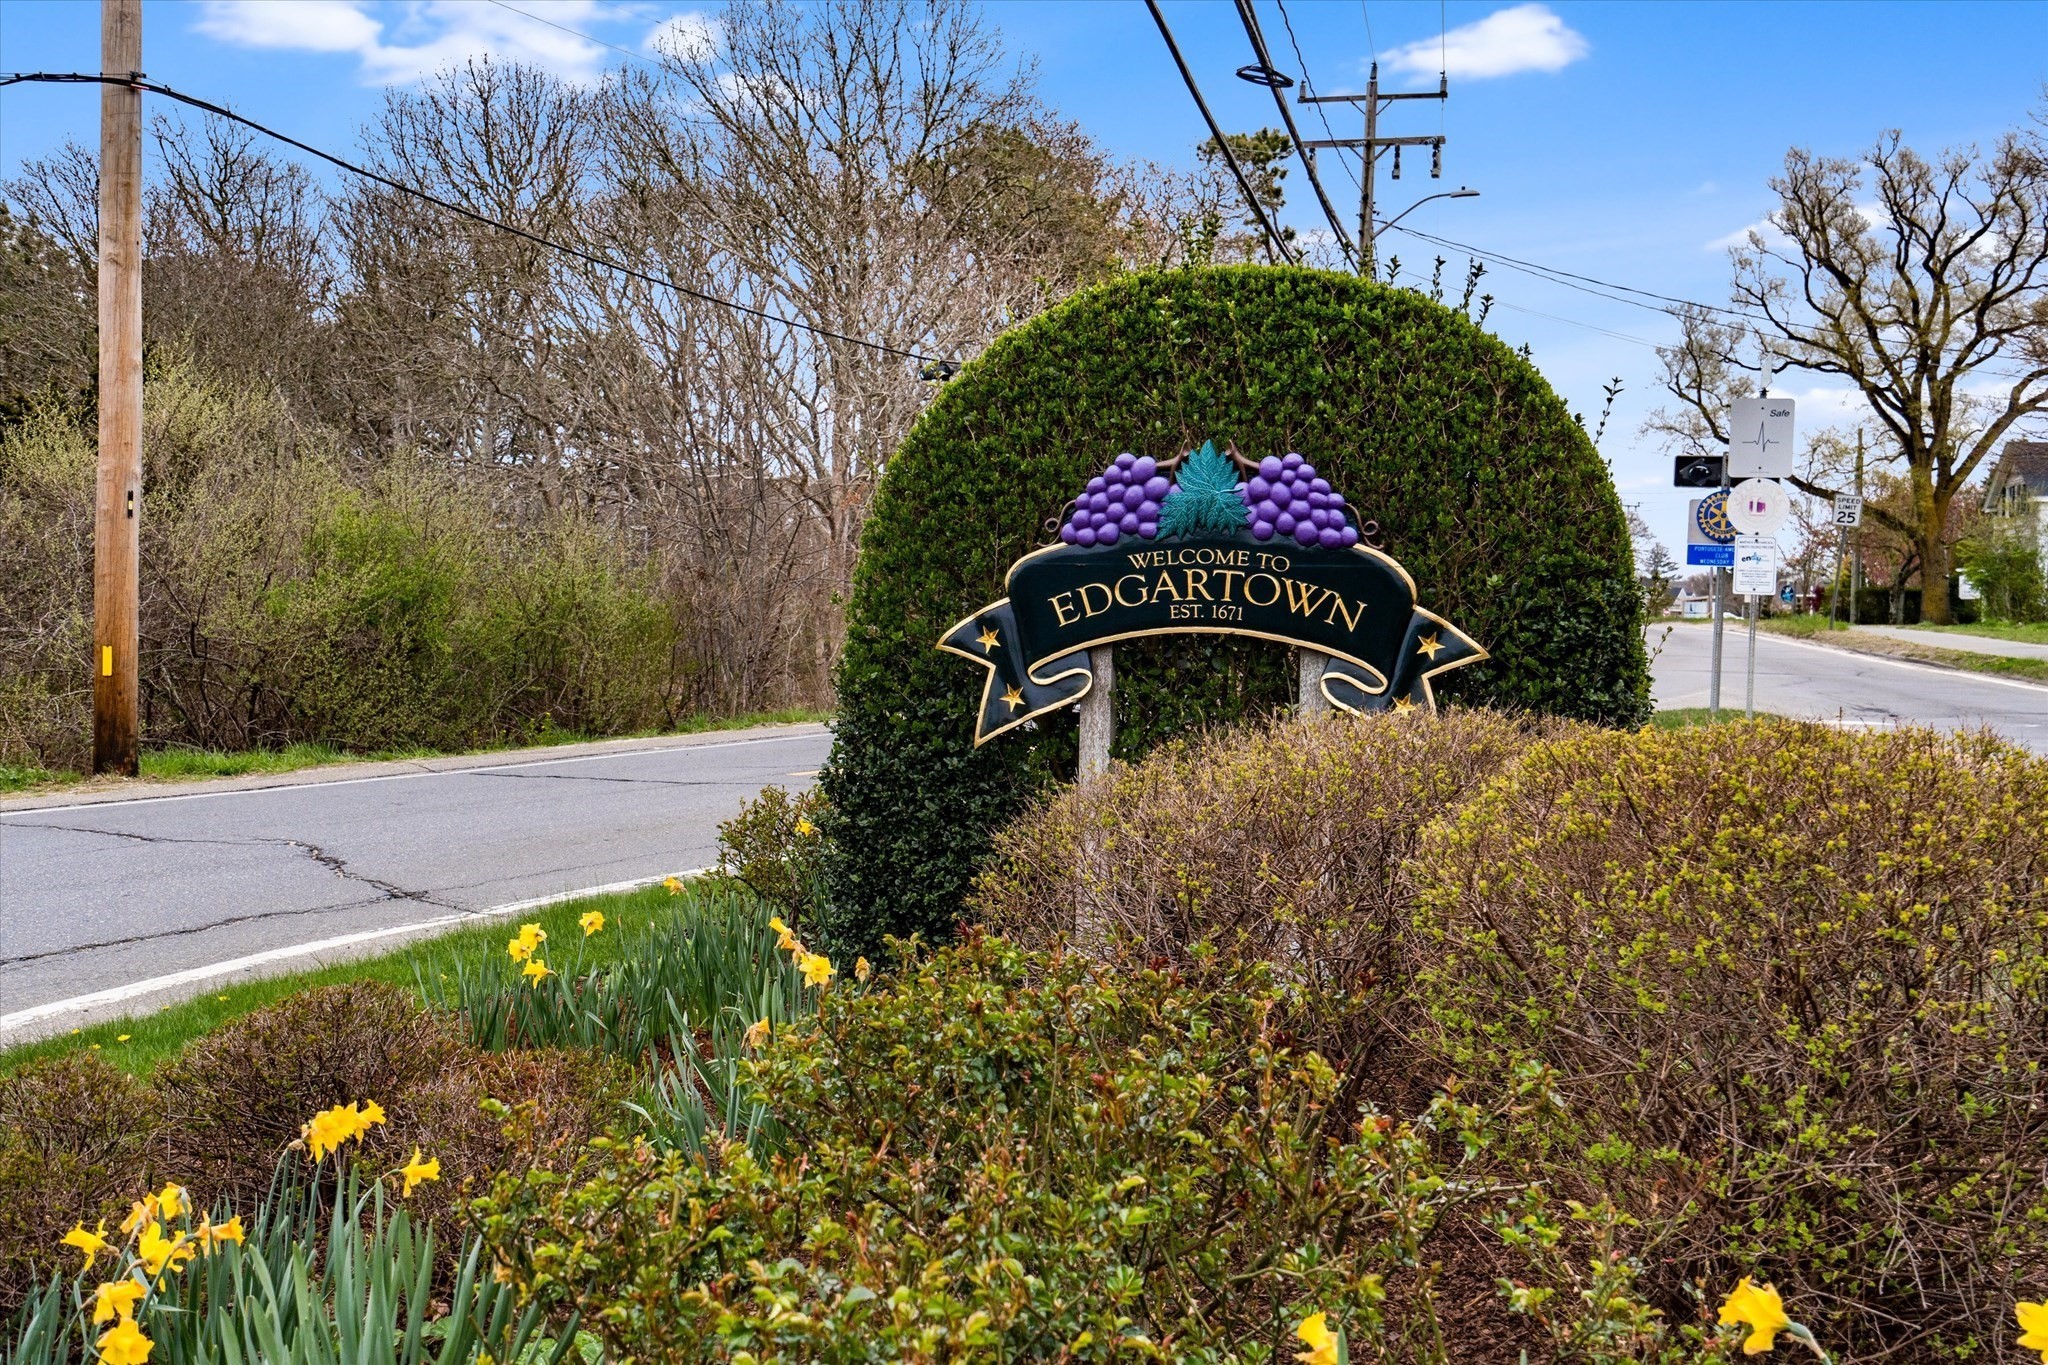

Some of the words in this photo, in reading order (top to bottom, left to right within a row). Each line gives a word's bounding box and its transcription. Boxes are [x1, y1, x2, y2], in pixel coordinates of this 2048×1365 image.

[1769, 409, 1790, 417] Safe
[1836, 511, 1856, 523] 25
[1127, 548, 1250, 569] WELCOME
[1256, 552, 1290, 573] TO
[1047, 568, 1369, 633] EDGARTOWN
[1169, 603, 1205, 619] EST.
[1211, 604, 1243, 621] 1671
